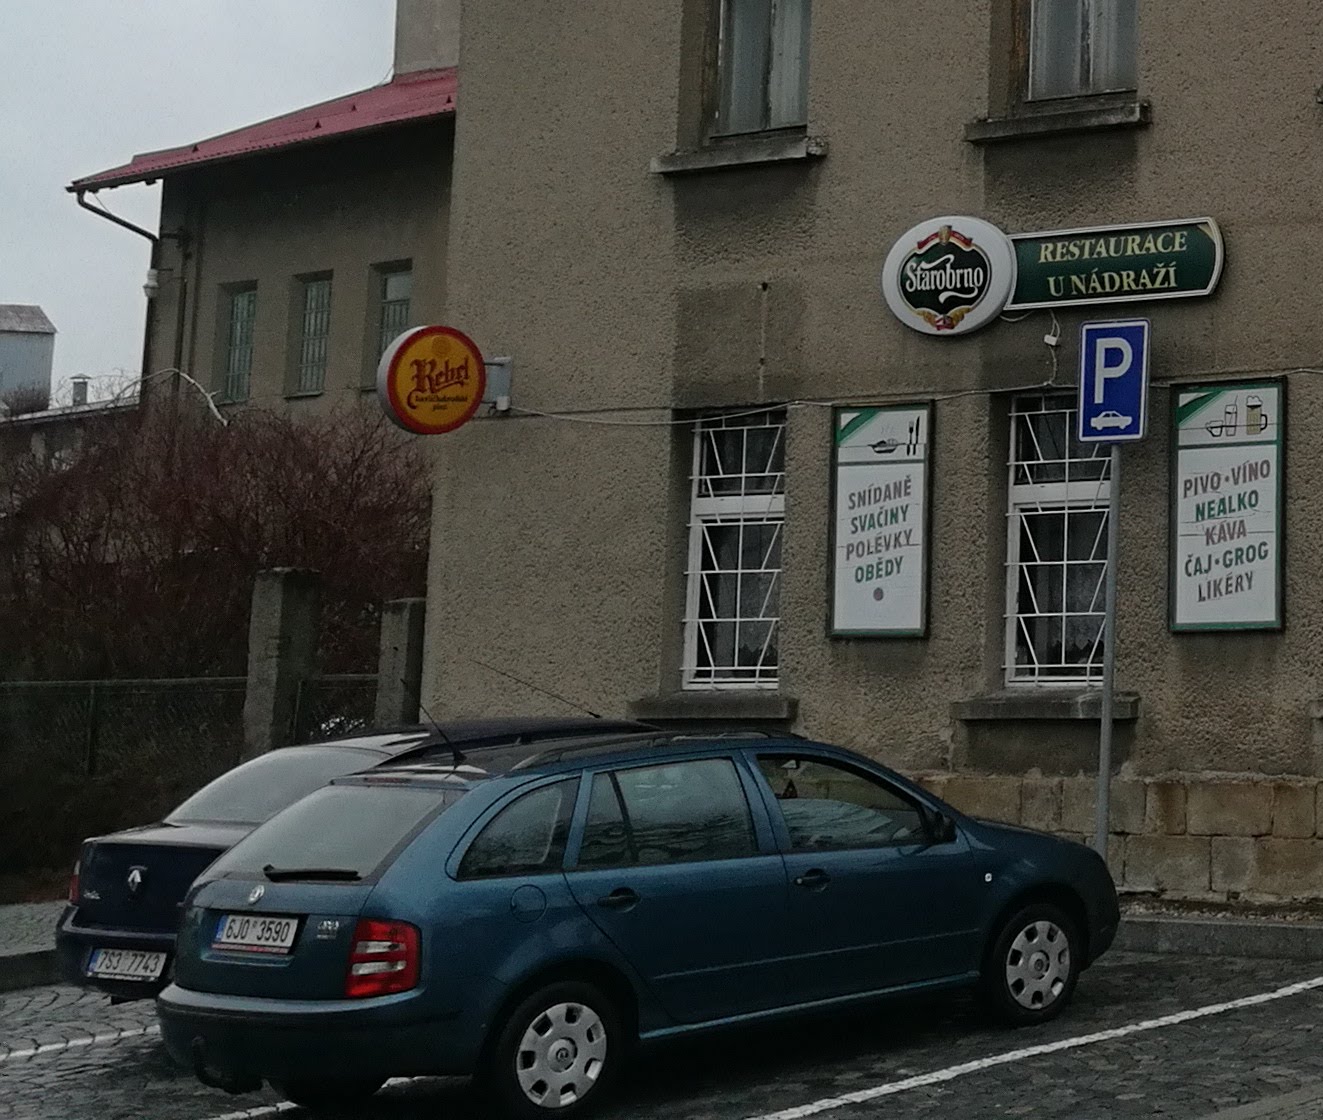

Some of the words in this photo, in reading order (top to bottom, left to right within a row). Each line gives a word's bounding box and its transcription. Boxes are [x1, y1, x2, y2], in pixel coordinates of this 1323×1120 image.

[1038, 230, 1188, 263] RESTAURACE
[905, 254, 984, 304] Starobrno
[1048, 275, 1067, 297] U
[1070, 261, 1178, 295] NÁDRAŽÍ
[1094, 337, 1133, 404] P
[848, 475, 912, 510] SNÍDANĚ
[1195, 489, 1259, 522] NEALKO
[851, 504, 910, 535] SVAČINY
[1205, 519, 1247, 546] KÁVA
[846, 528, 913, 561] POLÉVKY
[855, 556, 904, 583] OBĚDY
[1198, 570, 1254, 602] LIKÉRY
